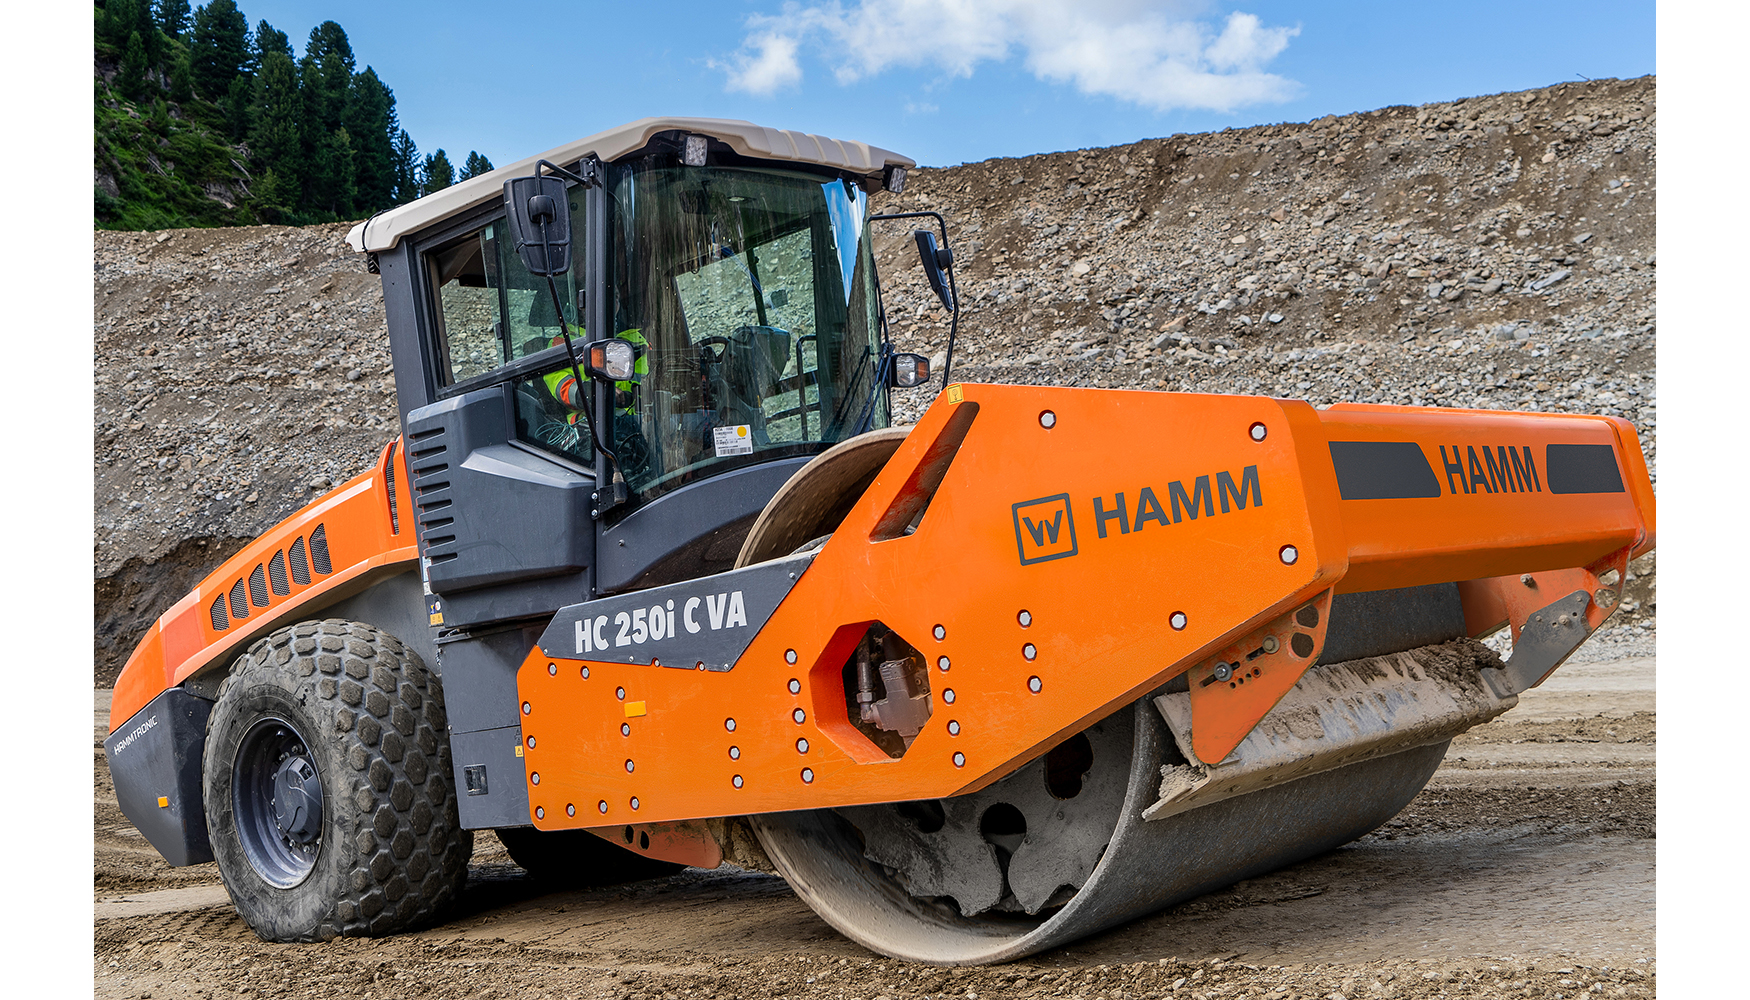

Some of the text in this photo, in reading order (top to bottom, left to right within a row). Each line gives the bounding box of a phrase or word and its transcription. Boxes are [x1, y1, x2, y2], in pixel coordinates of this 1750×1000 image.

[1438, 445, 1542, 494] HAMM
[1093, 464, 1263, 539] HAMM
[574, 590, 747, 654] HC 250i C VA
[113, 714, 158, 756] HAMMTRONIC
